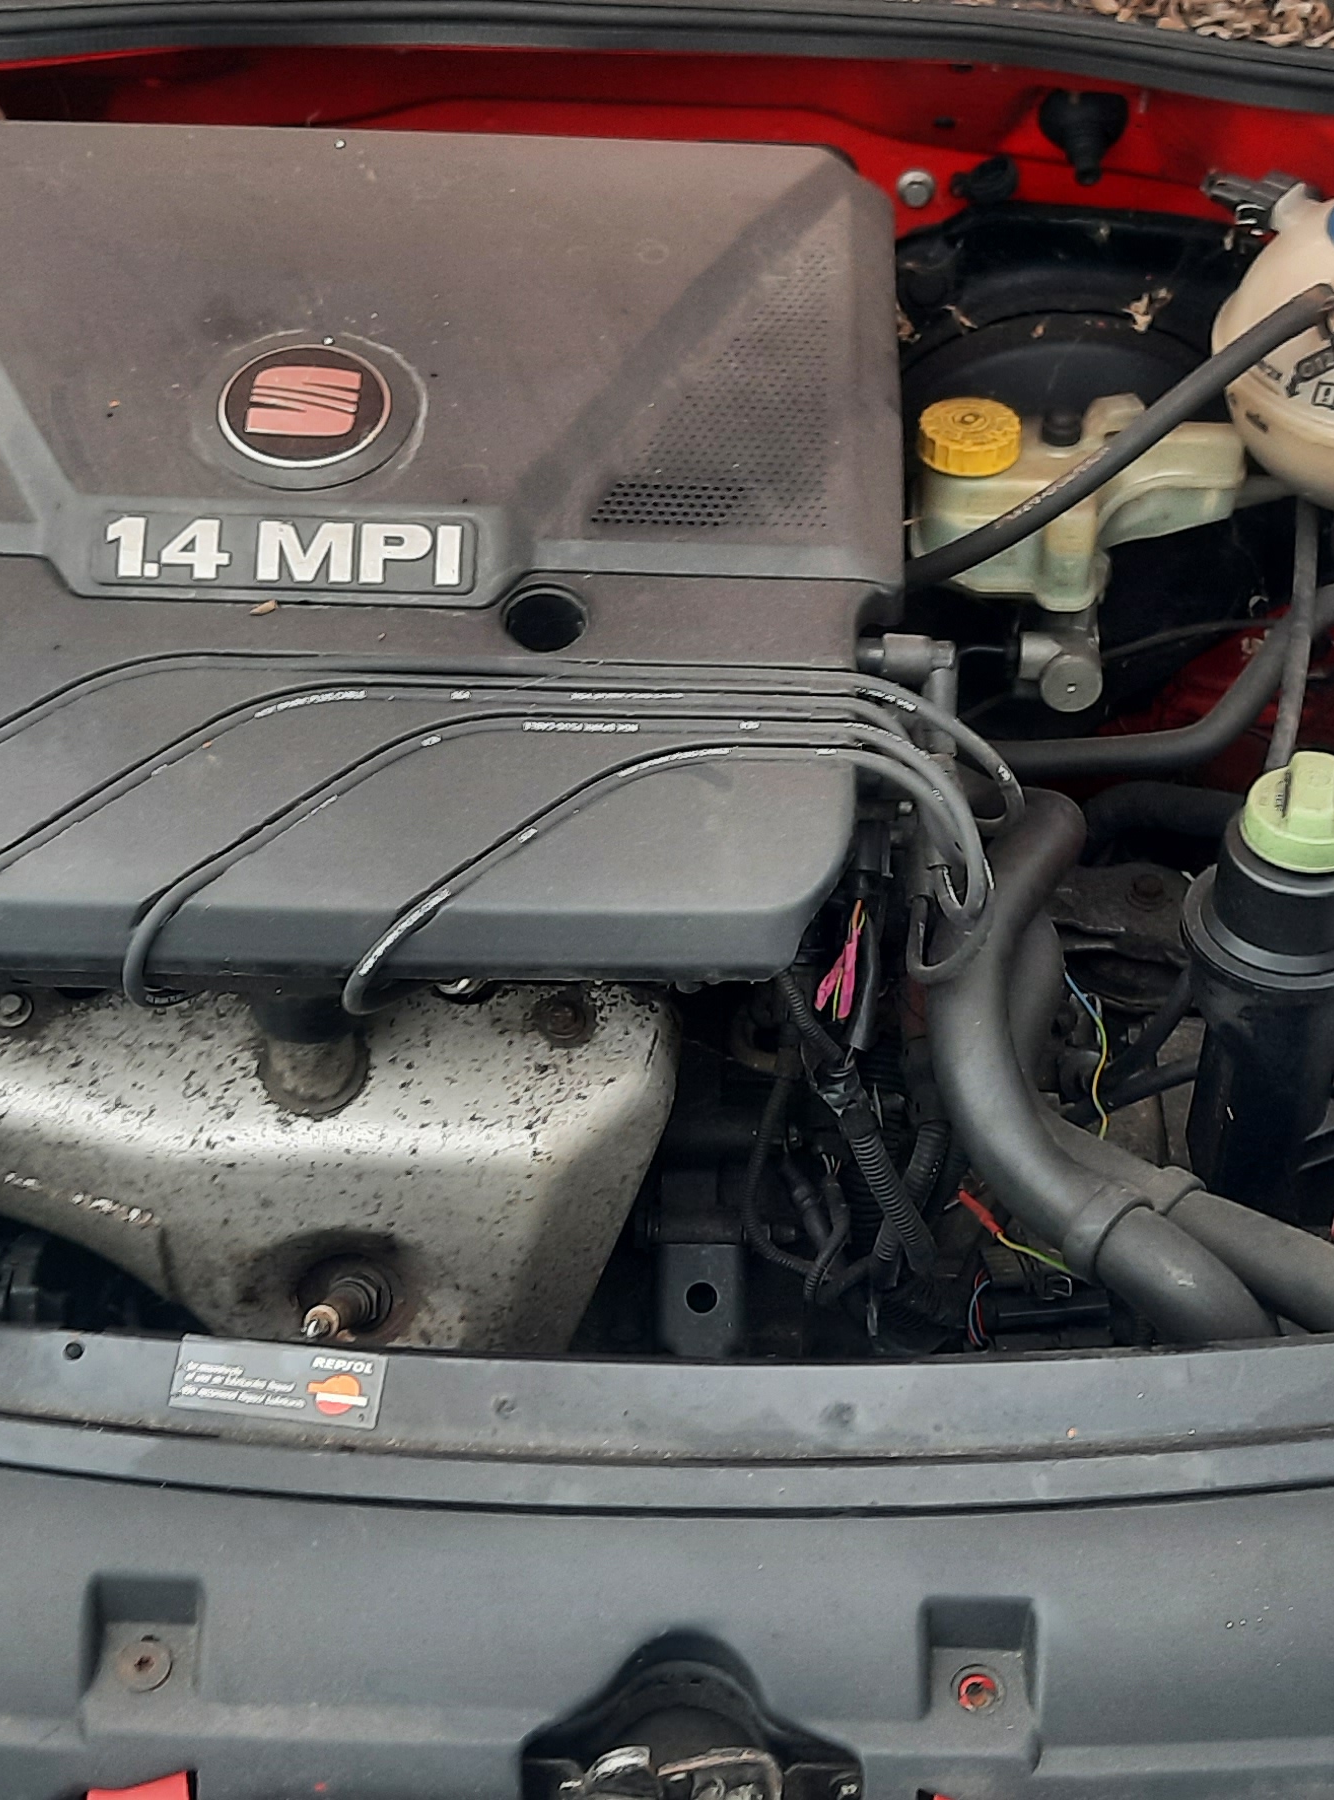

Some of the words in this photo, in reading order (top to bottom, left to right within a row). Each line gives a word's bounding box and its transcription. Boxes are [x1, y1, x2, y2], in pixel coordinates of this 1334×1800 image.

[105, 515, 232, 581] 1.4
[255, 520, 463, 587] MPI
[312, 1356, 374, 1374] REPSOL
